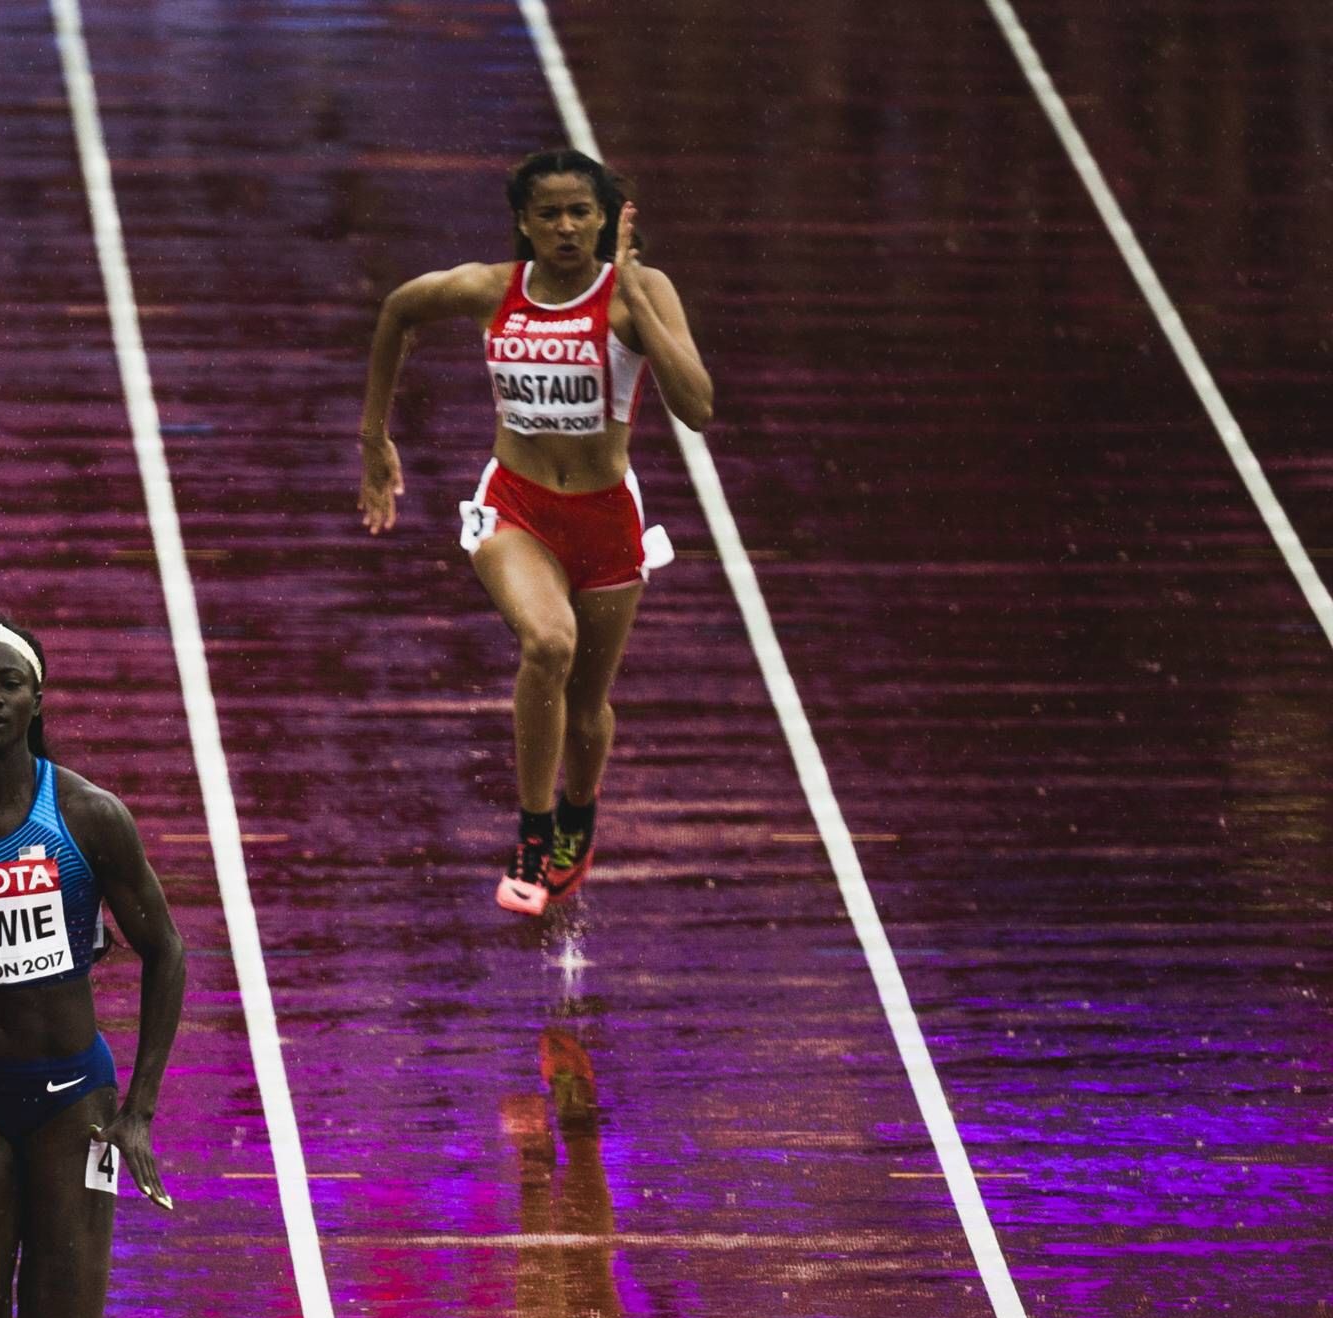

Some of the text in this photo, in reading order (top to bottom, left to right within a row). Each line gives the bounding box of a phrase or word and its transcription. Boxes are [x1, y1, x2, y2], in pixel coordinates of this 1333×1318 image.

[492, 336, 600, 363] TOYOTA
[495, 372, 599, 405] GASTAUD
[23, 950, 65, 975] 2017
[97, 1144, 115, 1183] 4
